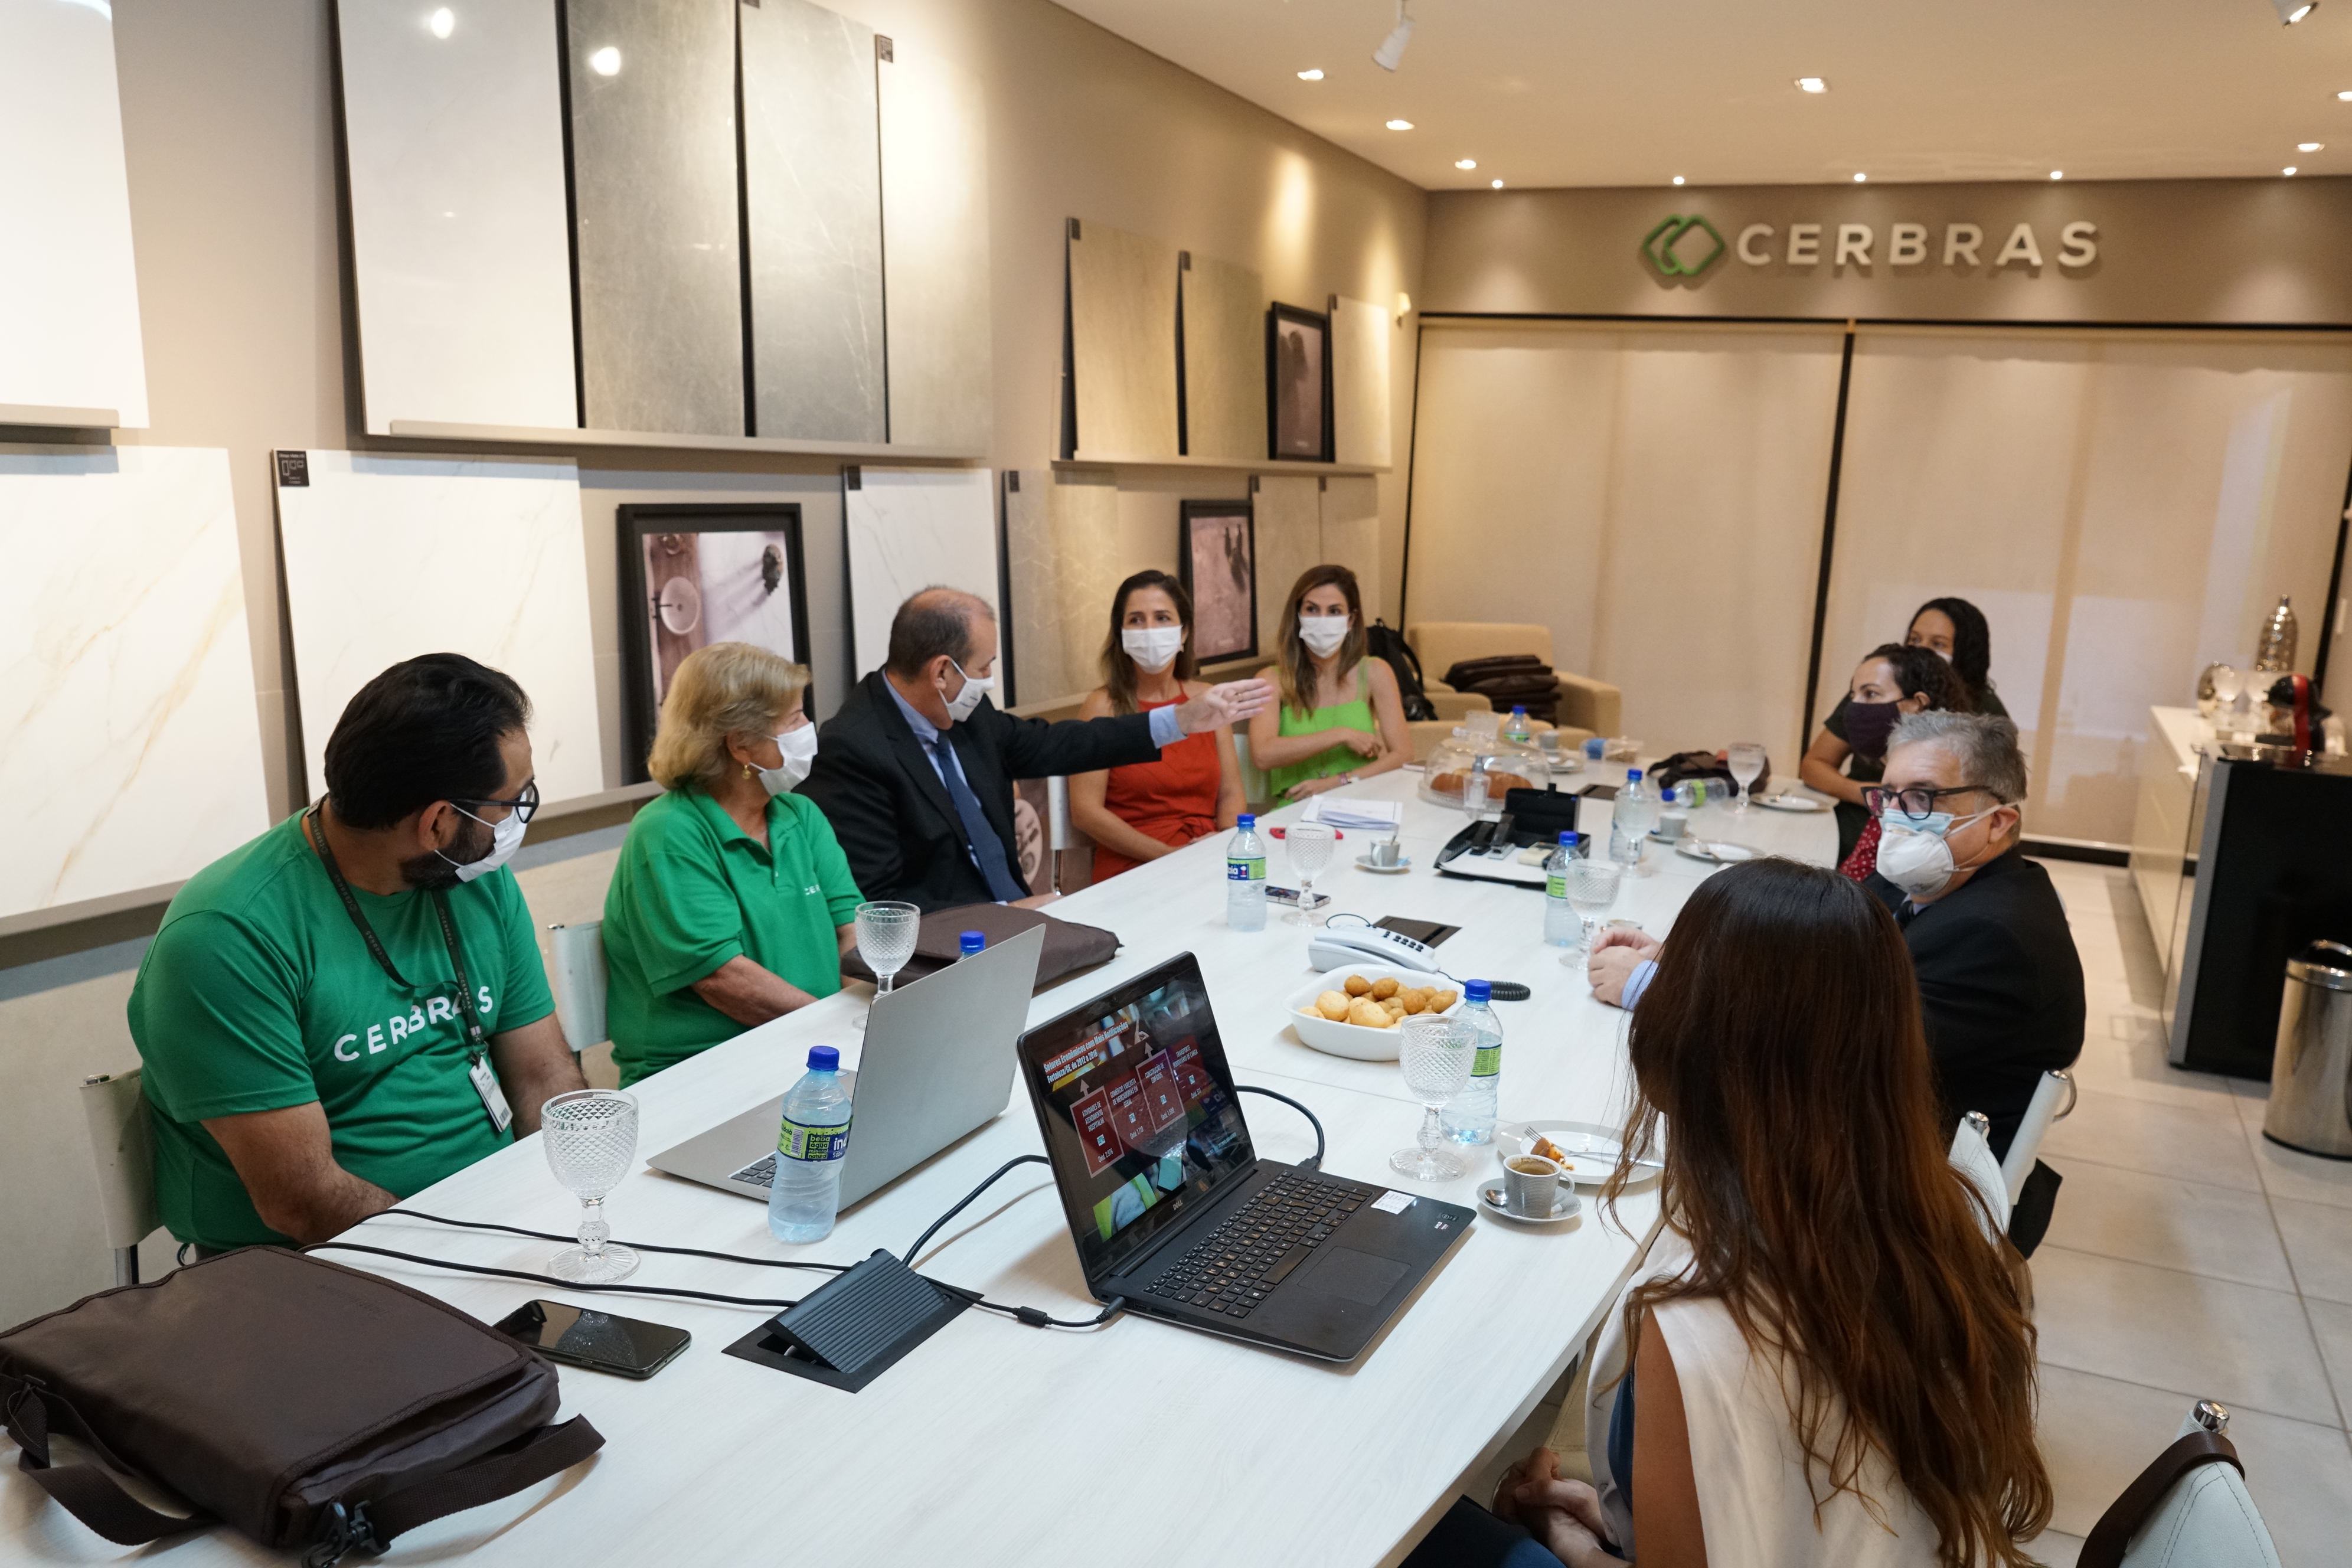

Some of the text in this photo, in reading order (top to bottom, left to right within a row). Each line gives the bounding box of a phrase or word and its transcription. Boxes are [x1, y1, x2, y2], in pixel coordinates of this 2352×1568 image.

[1737, 220, 2098, 267] CERBRAS
[1043, 1021, 1129, 1073] Setores Econômicos com Mais Notificações
[1076, 1056, 1086, 1067] 2012
[1088, 1049, 1098, 1060] 2018
[1082, 1100, 1102, 1118] ATIVIDADES DE
[1084, 1109, 1103, 1125] ATENDIMENTO
[1087, 1117, 1105, 1132] HOSPITALAR
[1172, 1199, 1183, 1211] DELL
